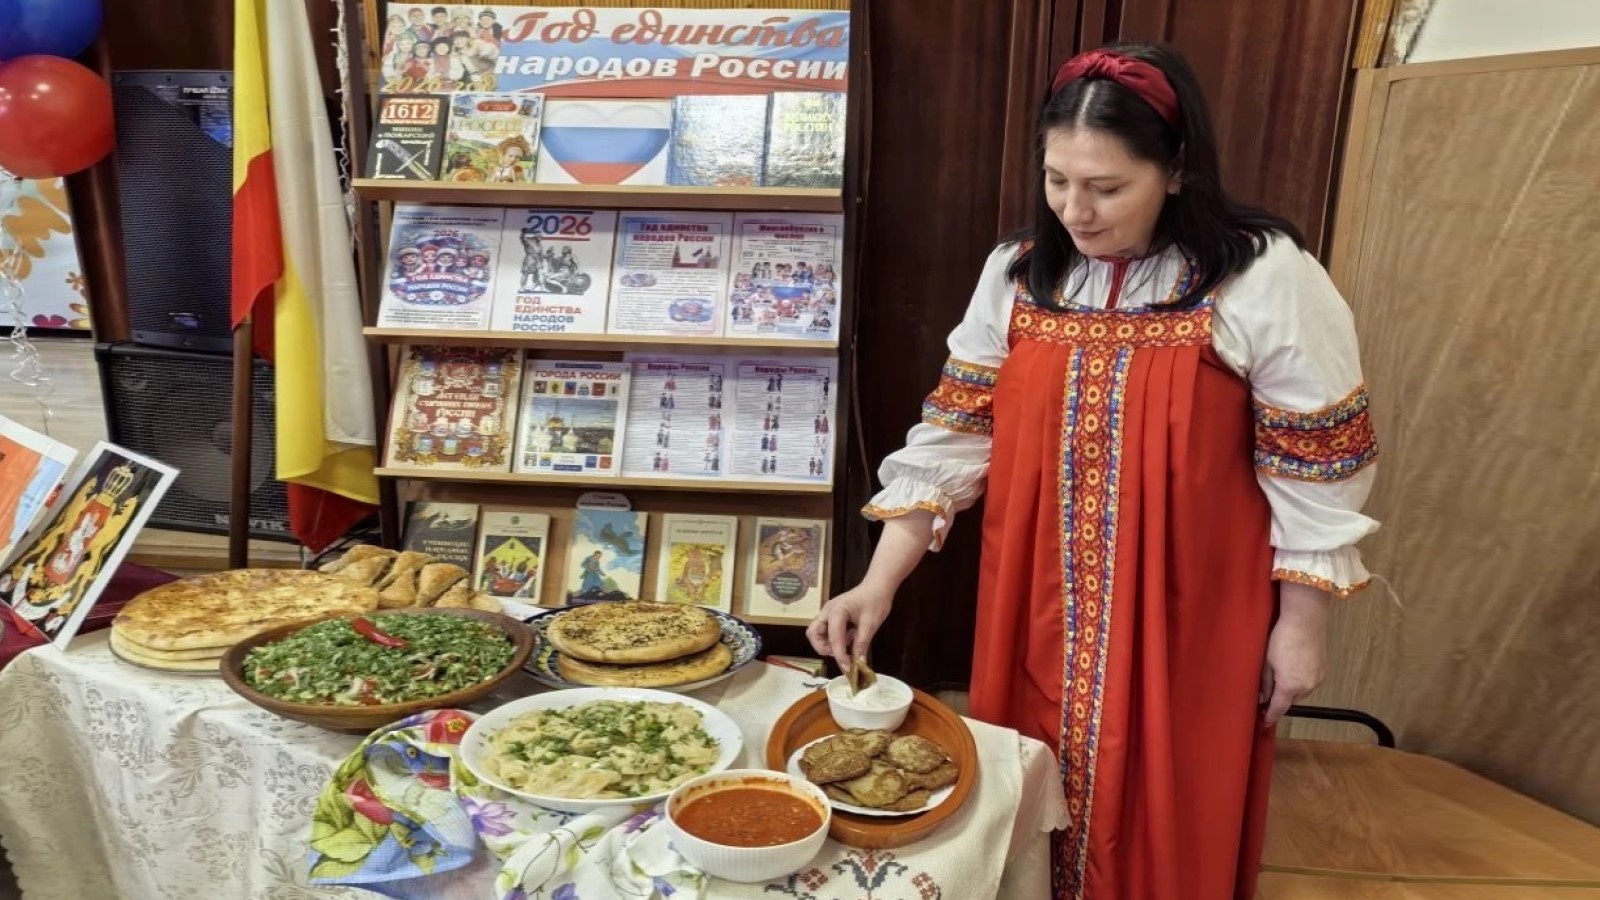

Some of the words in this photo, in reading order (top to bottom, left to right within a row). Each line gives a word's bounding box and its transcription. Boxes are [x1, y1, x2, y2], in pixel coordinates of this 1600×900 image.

[501, 8, 598, 45] Год
[611, 9, 848, 49] единства
[499, 53, 677, 82] народов
[690, 54, 848, 80] России
[387, 104, 432, 119] 1612
[526, 215, 593, 236] 2026
[516, 296, 541, 305] ГОД
[515, 305, 582, 314] ЕДИНСТВА
[513, 314, 574, 323] НАРОДОВ
[512, 323, 565, 332] РОССИИ
[536, 370, 577, 379] ГОРОДА
[580, 371, 621, 380] РОССИИ
[214, 514, 286, 531] NVIK
